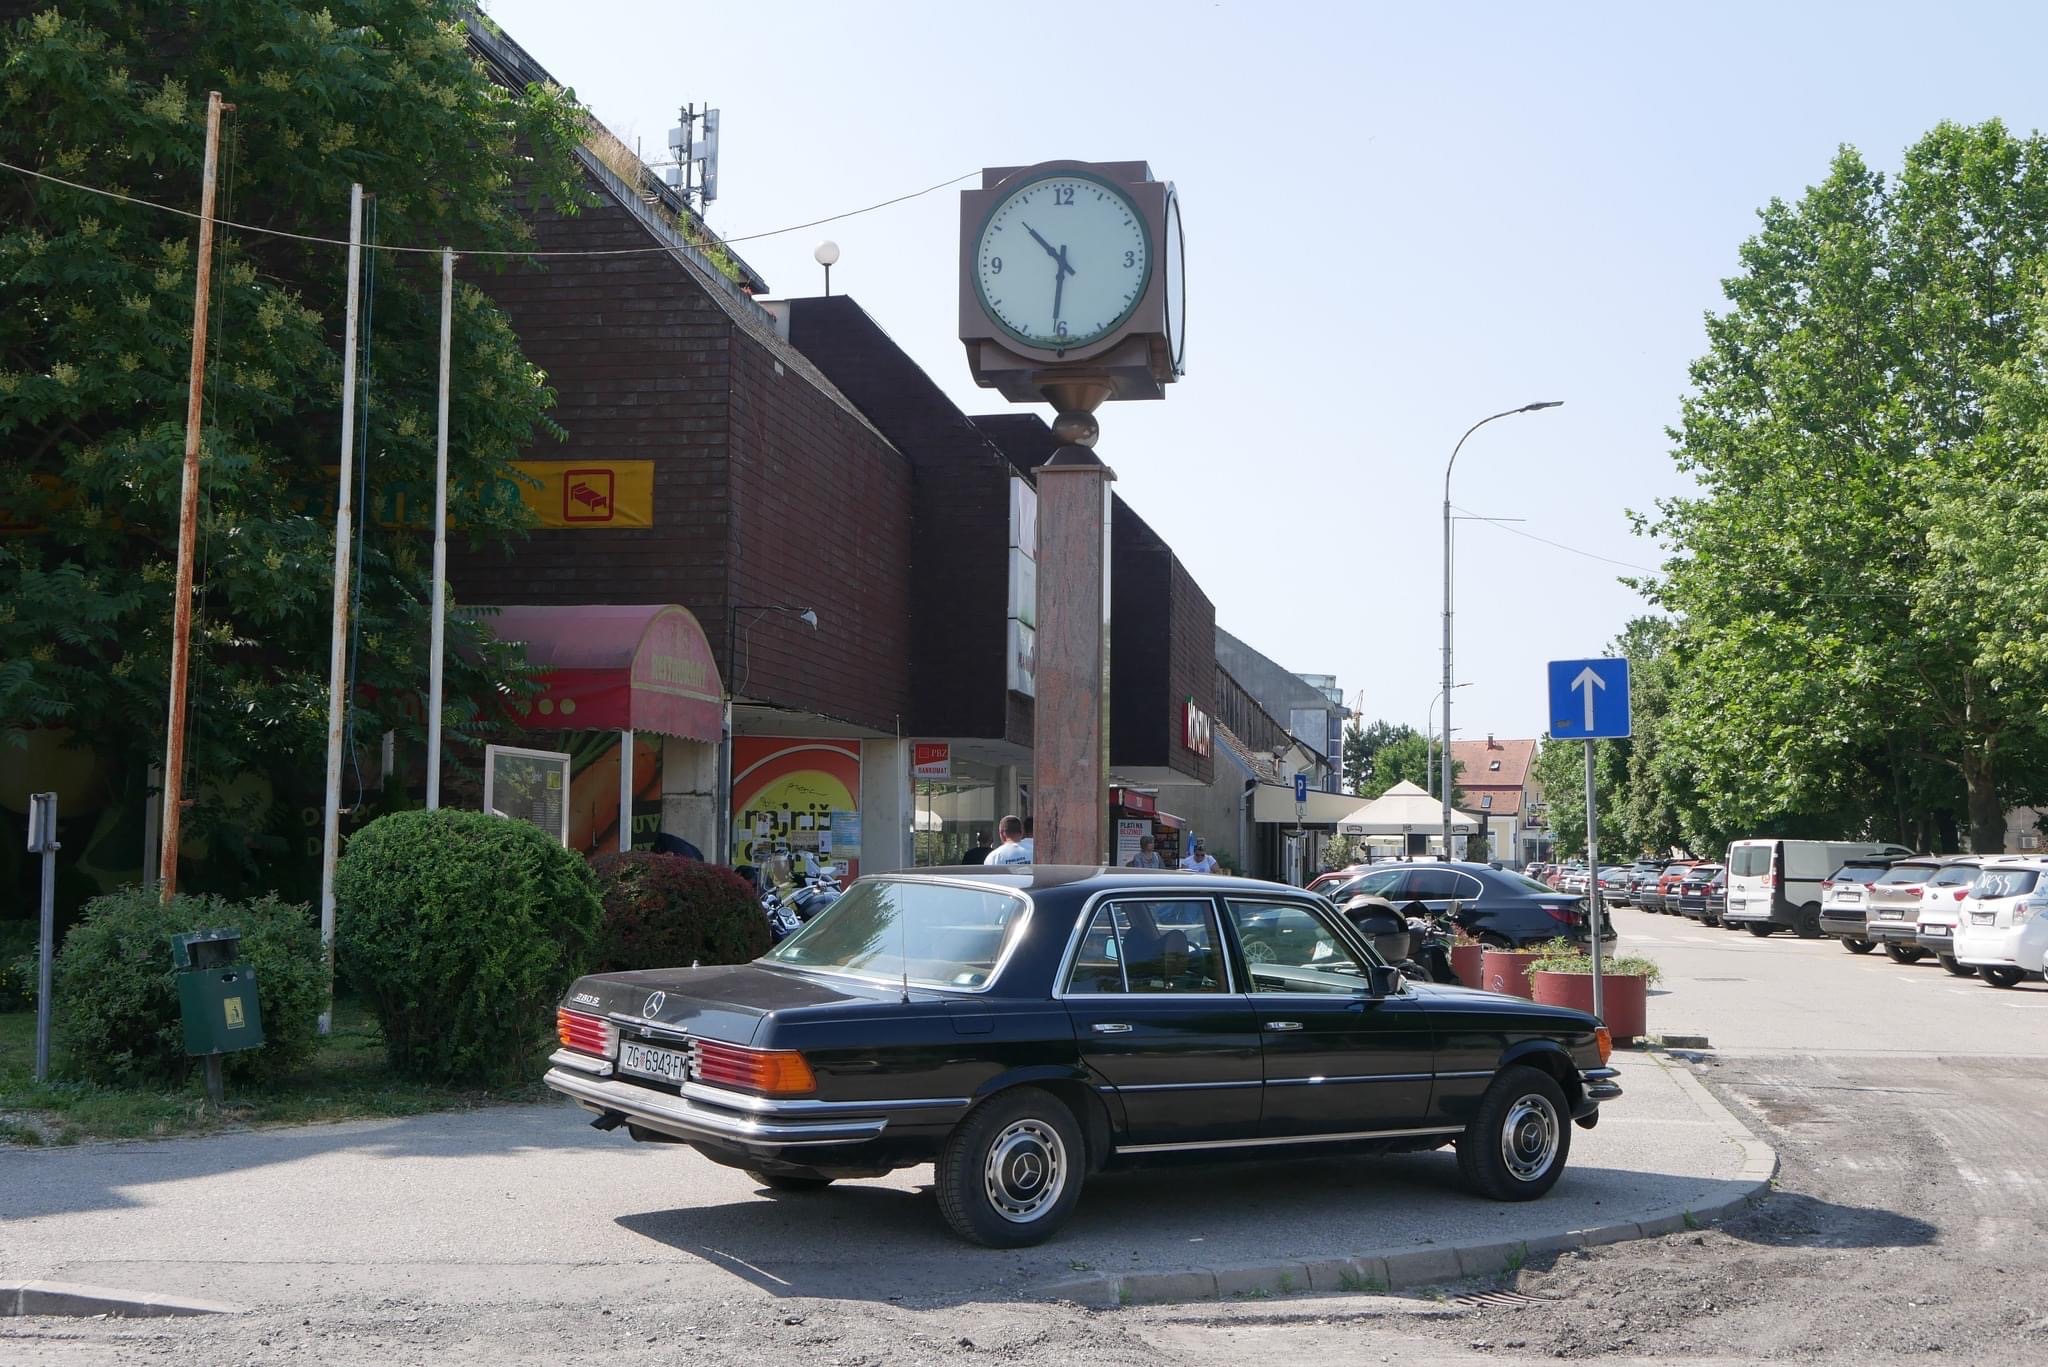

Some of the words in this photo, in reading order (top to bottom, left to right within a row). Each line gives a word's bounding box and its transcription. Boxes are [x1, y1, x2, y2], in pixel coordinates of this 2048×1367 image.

[1053, 187, 1074, 206] 12
[991, 257, 1003, 275] 9
[1122, 250, 1135, 269] 3
[1056, 321, 1068, 338] 6
[1187, 696, 1211, 758] KONZUM
[931, 748, 947, 759] PBZ
[918, 767, 948, 775] BANKOMAT
[1298, 779, 1304, 797] P
[626, 1046, 639, 1067] ZG
